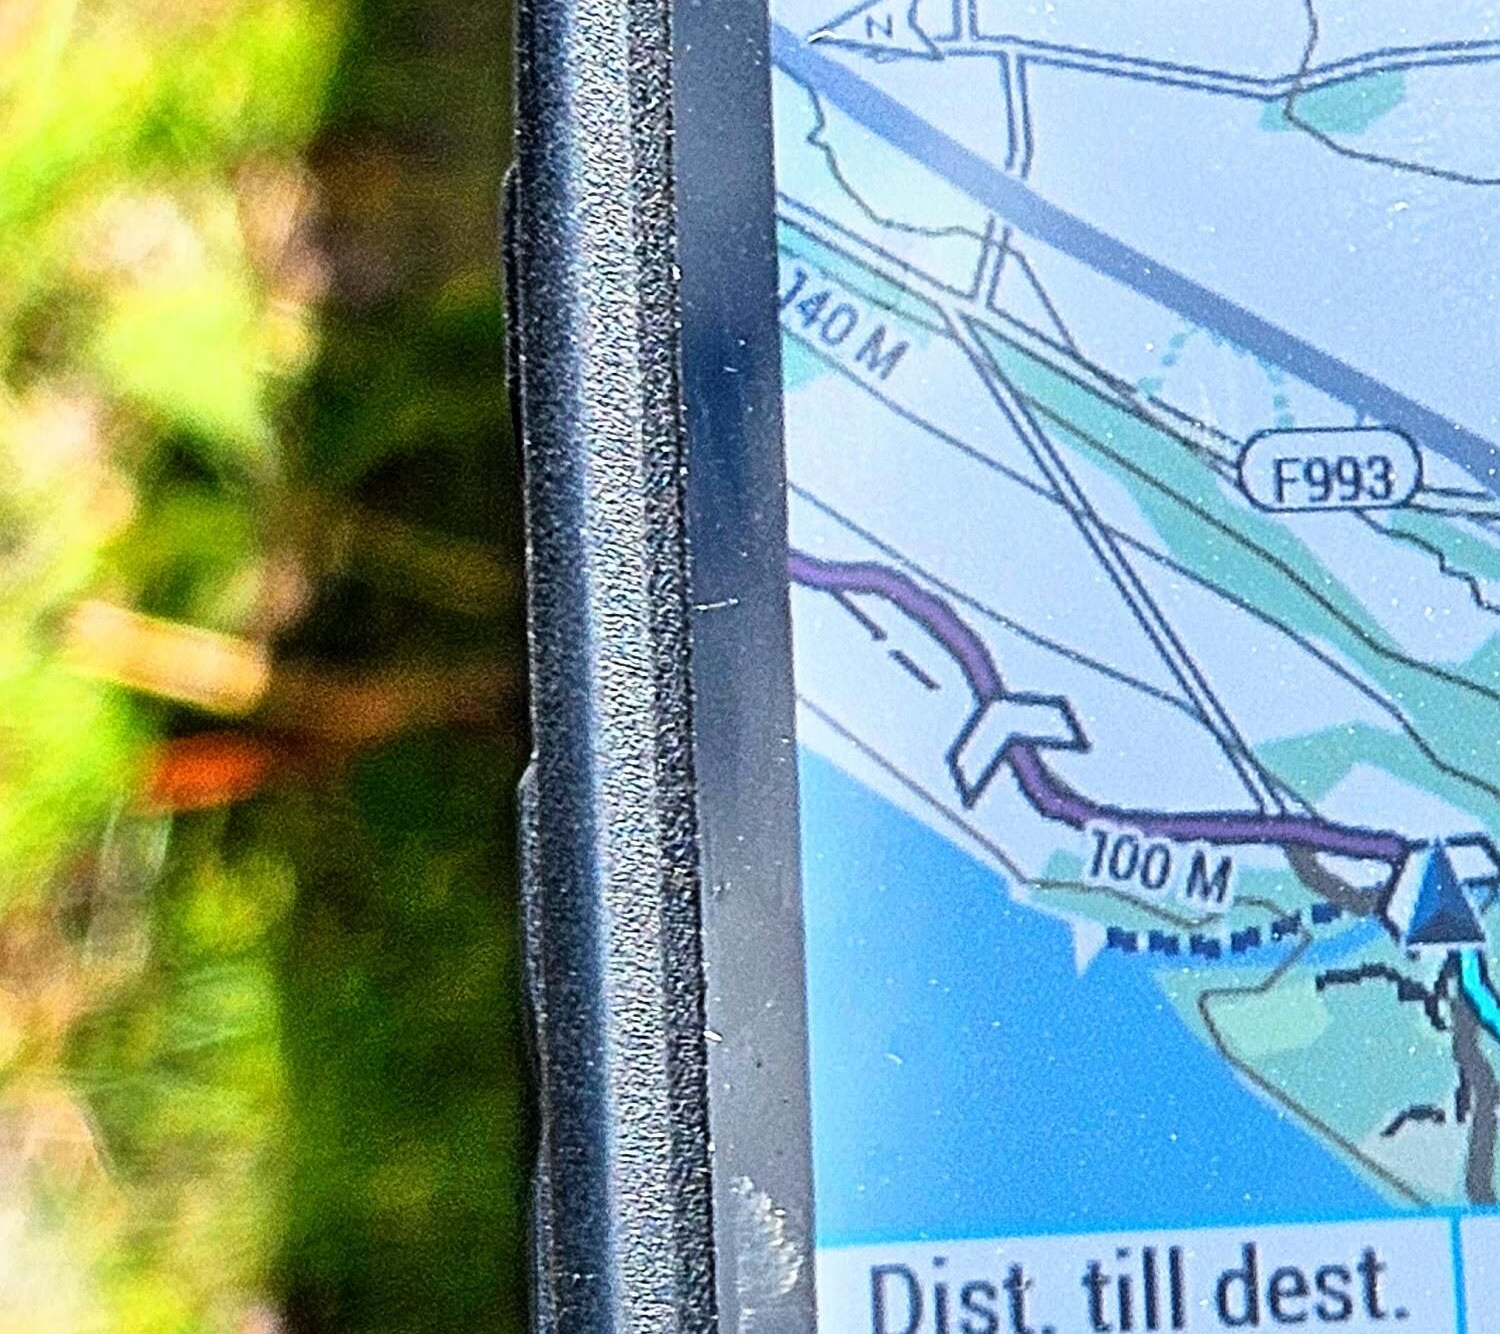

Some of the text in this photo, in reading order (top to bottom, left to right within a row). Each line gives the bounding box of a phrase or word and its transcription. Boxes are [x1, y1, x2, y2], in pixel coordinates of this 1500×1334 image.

[865, 14, 893, 39] N
[781, 268, 910, 380] 140 M
[1273, 455, 1394, 503] F993
[1089, 828, 1232, 903] 100 M
[1082, 1246, 1185, 1333] till
[1213, 1241, 1410, 1327] dest.
